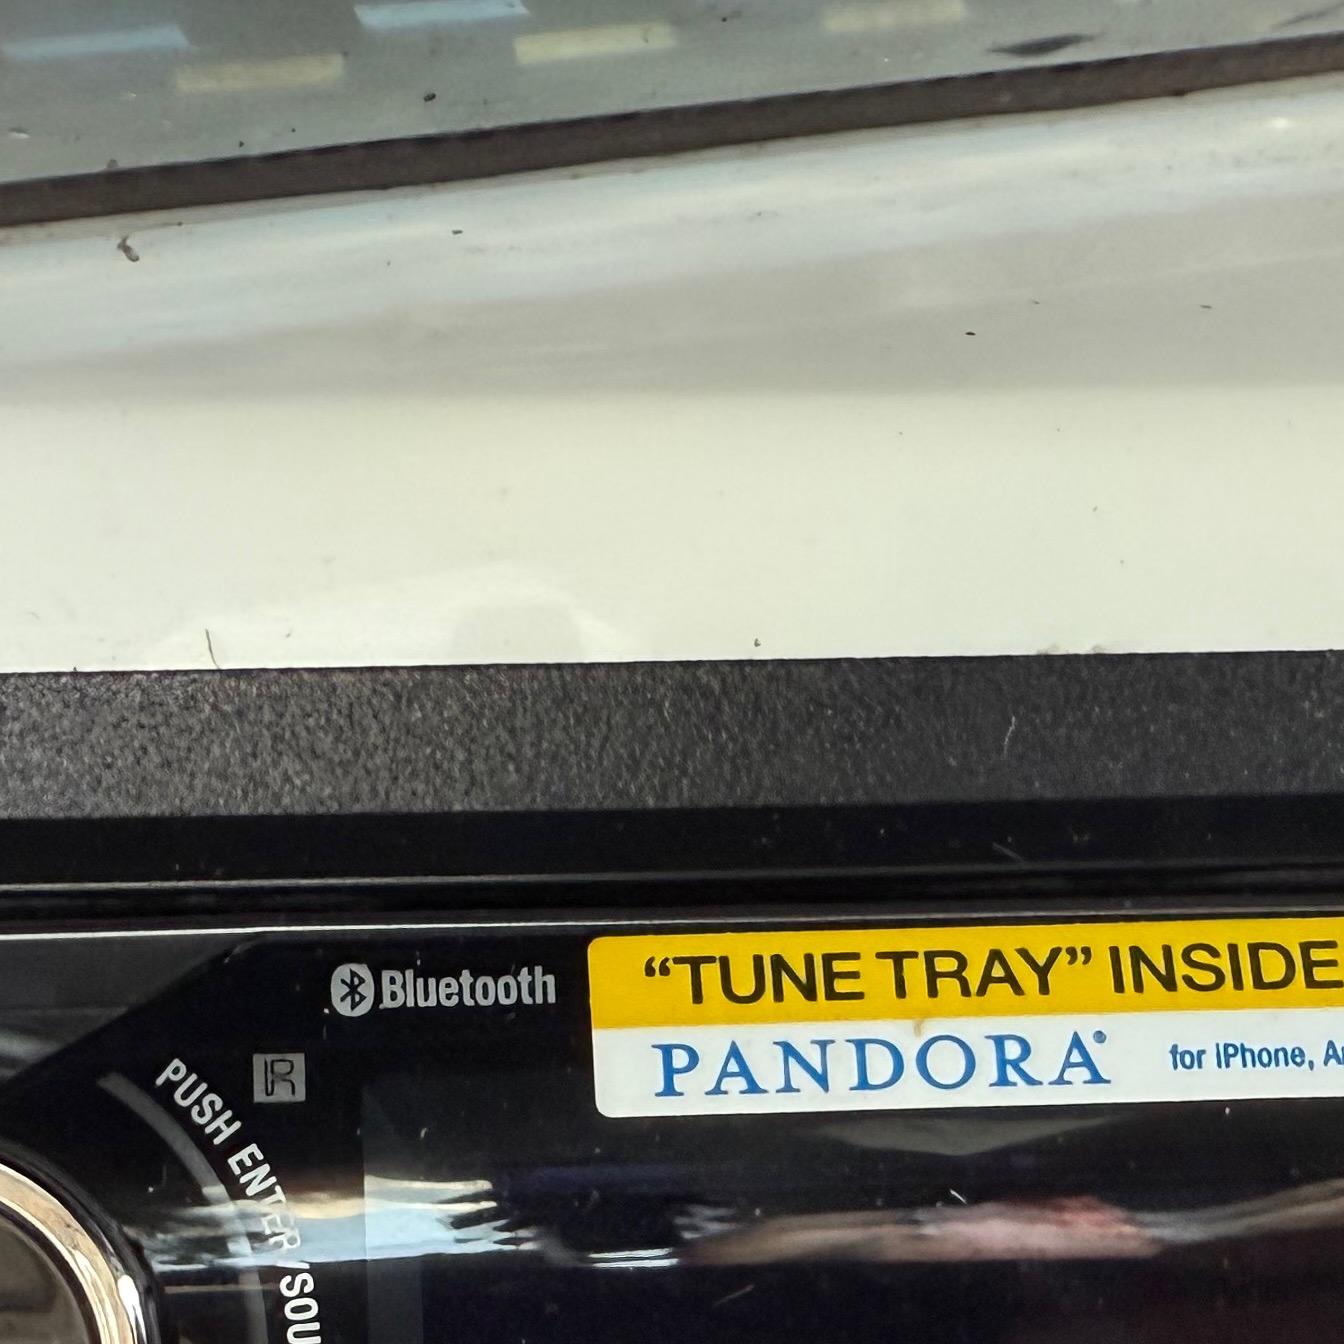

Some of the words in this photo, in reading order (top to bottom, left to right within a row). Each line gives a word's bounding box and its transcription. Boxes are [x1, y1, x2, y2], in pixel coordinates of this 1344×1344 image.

[379, 965, 556, 1009] Bluetooth
[1111, 939, 1344, 994] INSIDE
[1168, 1042, 1206, 1071] for
[156, 1057, 243, 1145] PUSH
